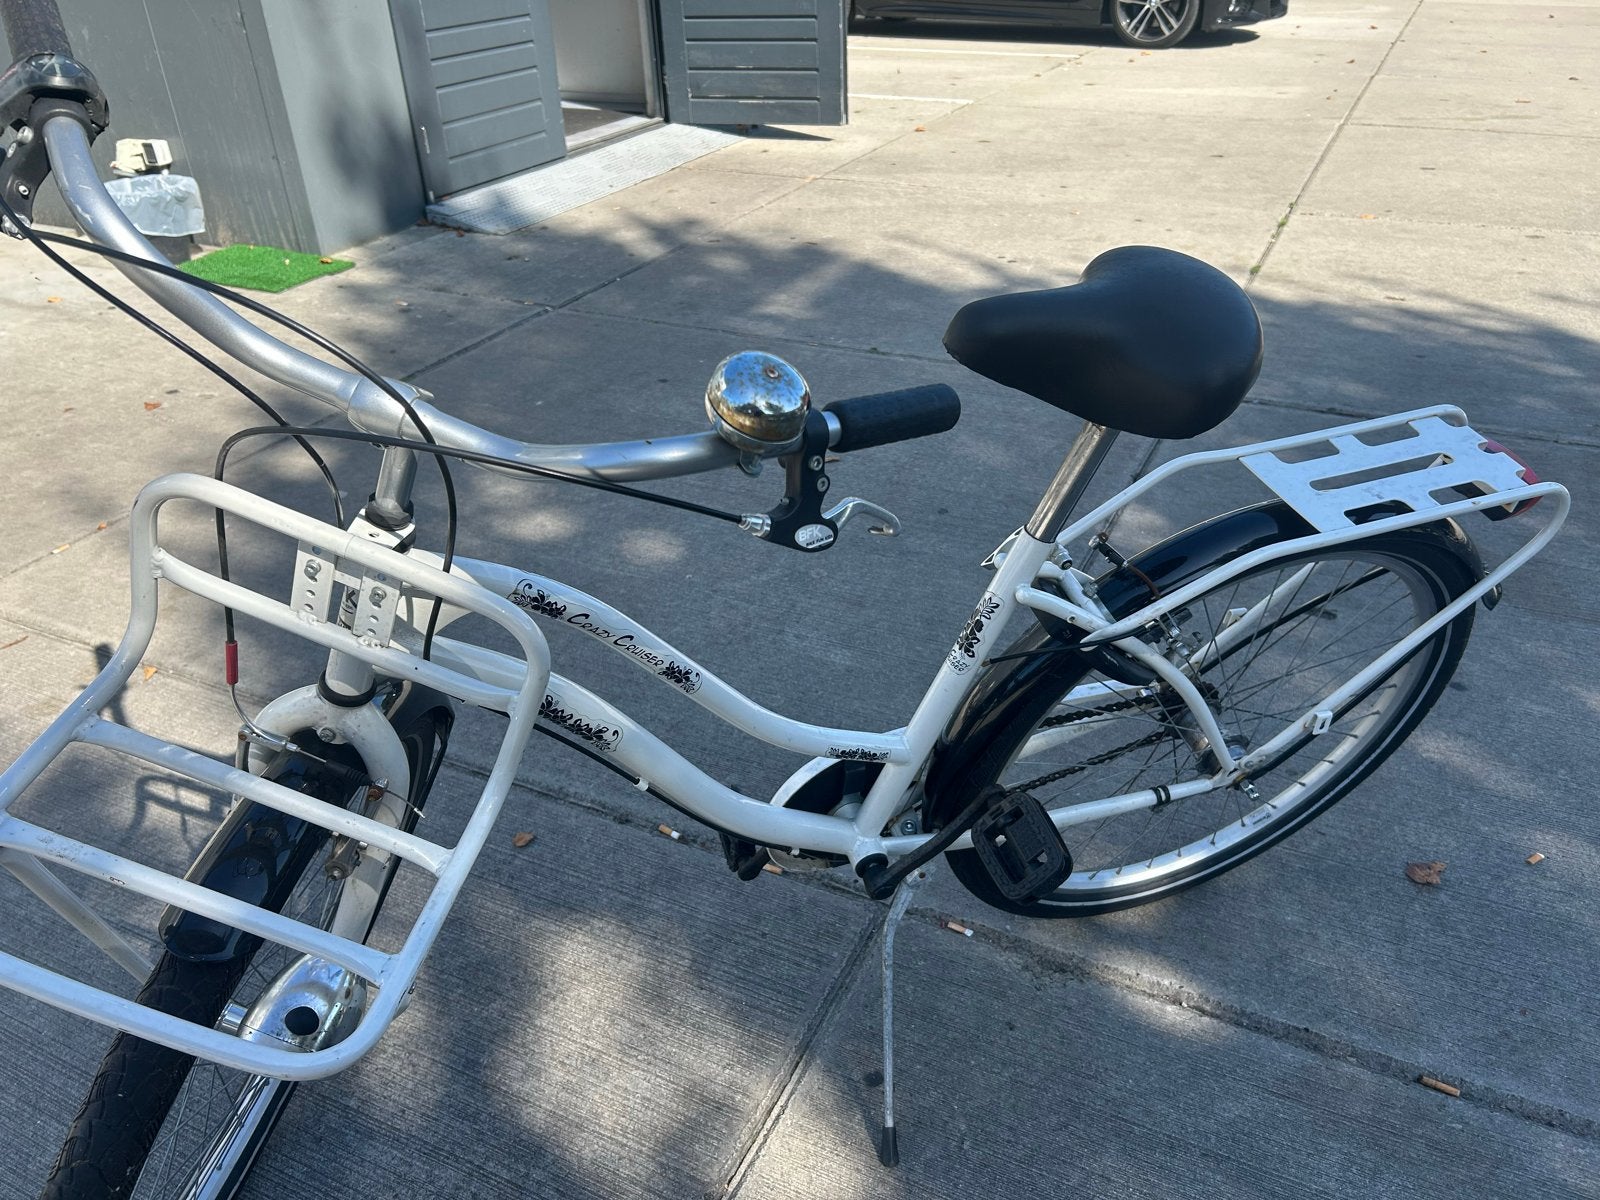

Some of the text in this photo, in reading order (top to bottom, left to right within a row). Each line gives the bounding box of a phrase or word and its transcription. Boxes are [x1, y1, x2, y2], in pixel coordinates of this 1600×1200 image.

[798, 525, 822, 541] BFK
[567, 613, 664, 667] CRAZY CRUISER
